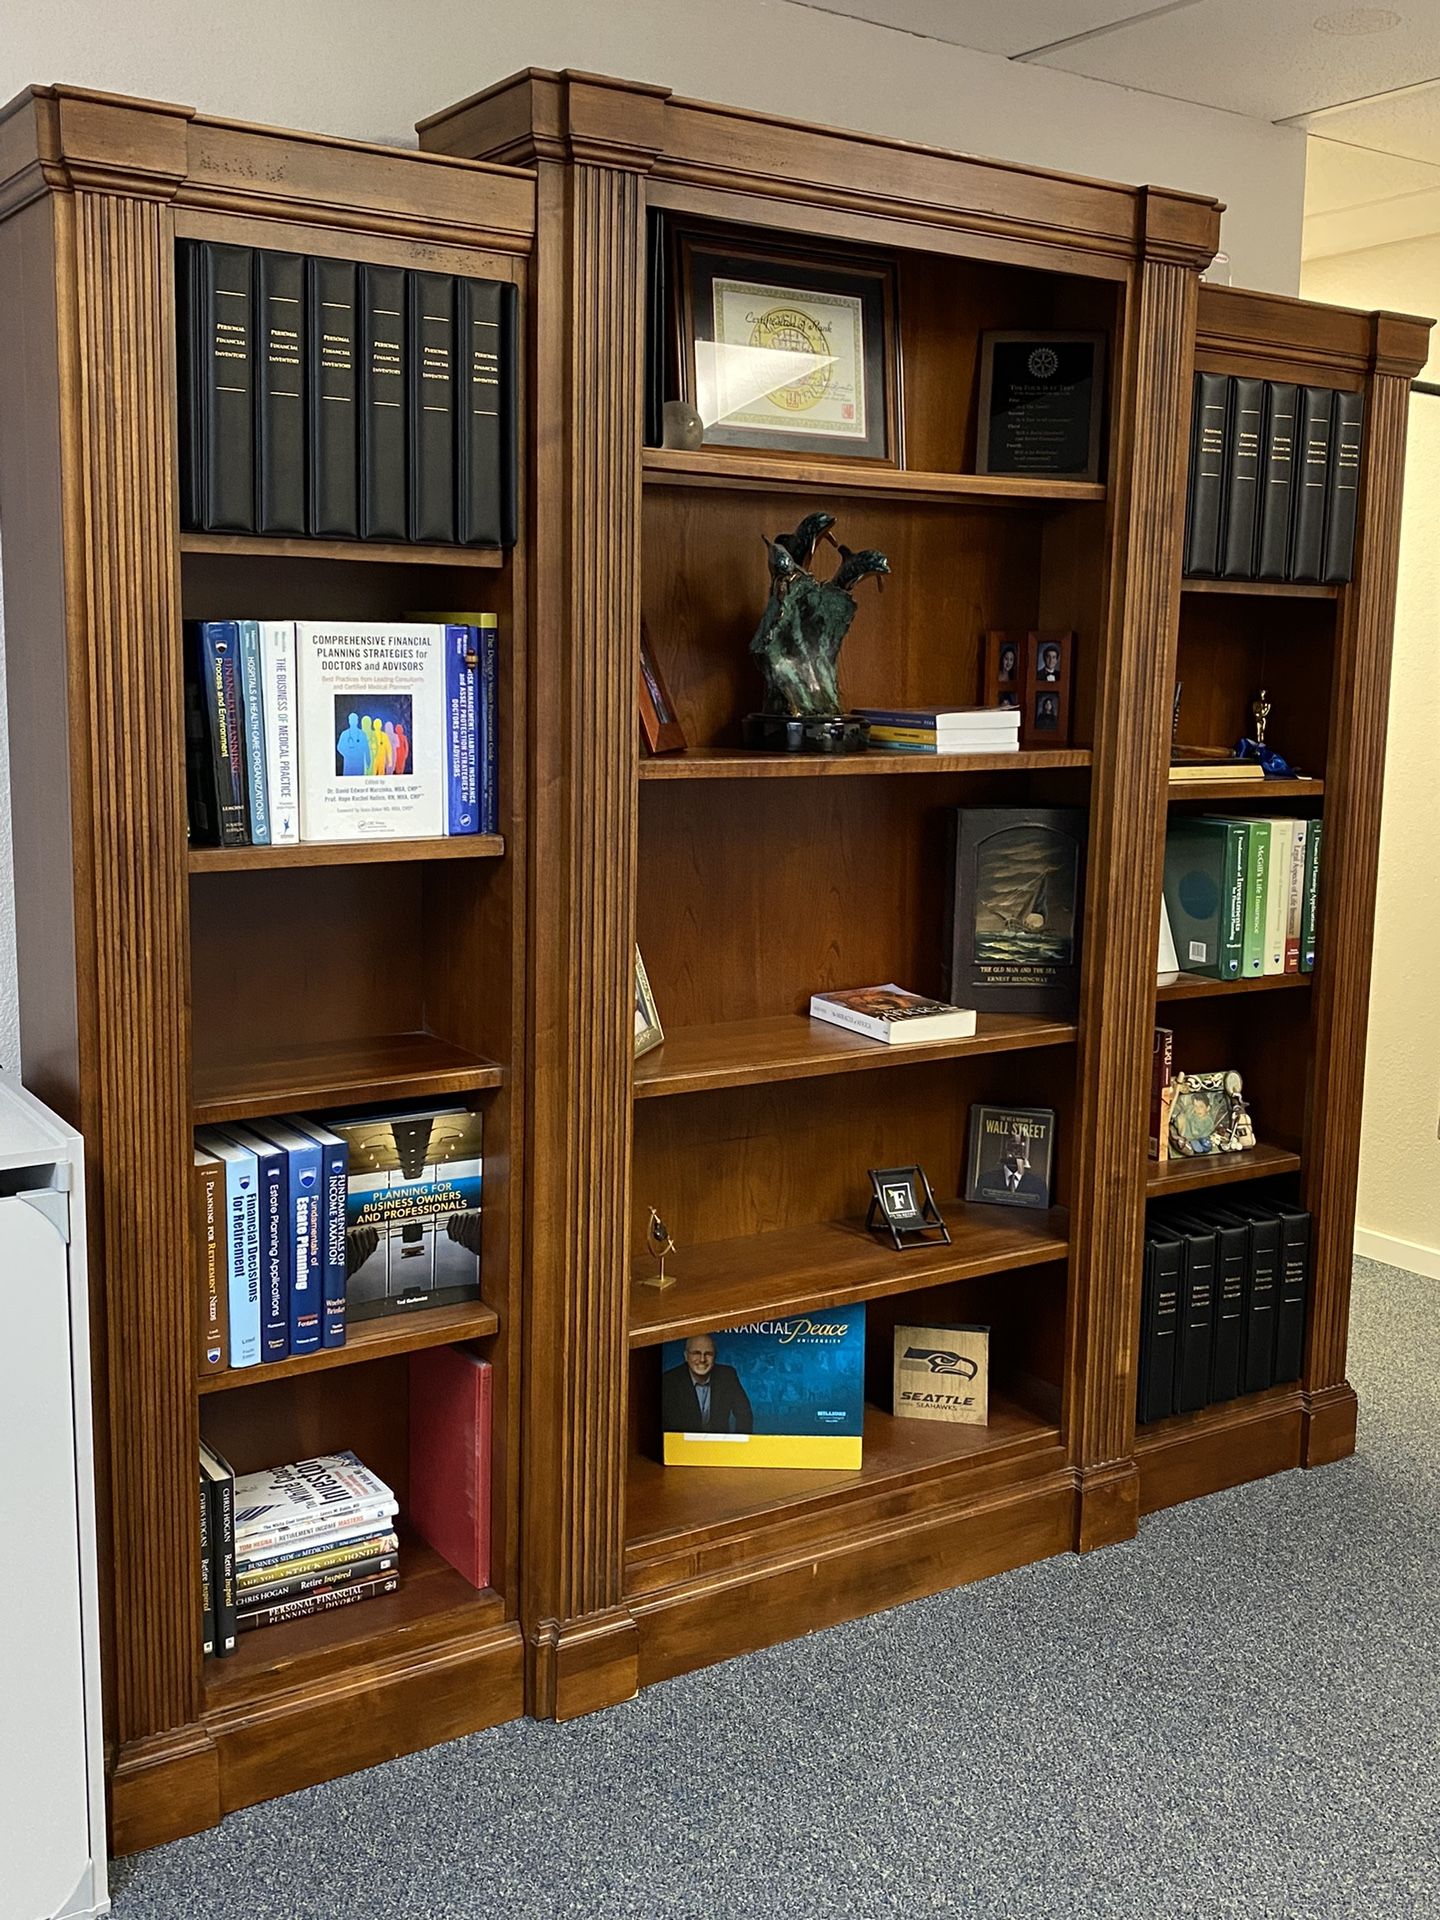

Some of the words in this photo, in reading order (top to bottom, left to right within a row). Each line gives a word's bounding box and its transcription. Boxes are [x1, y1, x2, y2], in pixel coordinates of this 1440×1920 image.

[313, 635, 386, 646] COMPREHENSIVE
[388, 636, 431, 646] FINANCIAL
[317, 648, 360, 658] PLANNING
[363, 649, 413, 658] STRATEGIES
[416, 650, 427, 658] for
[247, 656, 257, 694] HOSPITALS
[276, 658, 286, 672] THE
[322, 661, 361, 670] DOCTORS
[364, 662, 380, 670] and
[383, 662, 424, 670] ADVISORS
[225, 657, 235, 714] FINANCIAL
[277, 674, 287, 711] BUSINESS
[250, 703, 259, 729] HEALTH
[278, 714, 288, 723] OF
[219, 708, 229, 757] Environment
[252, 731, 260, 750] CARE
[278, 725, 289, 758] MEDICAL
[253, 751, 264, 820] ORGANIZATIONS
[280, 761, 291, 797] PRACTICE
[1257, 845, 1265, 877] McGill's
[1291, 845, 1300, 862] Legal
[1236, 878, 1244, 931] Investments
[986, 1120, 1009, 1134] WALL
[1011, 1123, 1046, 1138] STREET
[233, 1196, 244, 1213] for
[270, 1184, 278, 1214] Estate
[363, 1197, 413, 1212] BUSINESS
[416, 1191, 461, 1204] OWNERS
[373, 1185, 428, 1201] PLANNING
[432, 1182, 452, 1192] FOR
[893, 1190, 906, 1209] F
[247, 1193, 257, 1245] Financial
[297, 1197, 310, 1235] Estate
[311, 1195, 319, 1255] Fundamentals
[338, 1175, 346, 1252] FUNDAMENTALS
[357, 1212, 380, 1224] AND
[384, 1200, 467, 1220] PROFESSIONALS
[234, 1215, 245, 1278] Retirement
[270, 1216, 279, 1256] Planning
[296, 1236, 309, 1290] Planning
[311, 1257, 318, 1266] of
[338, 1255, 345, 1266] OF
[249, 1248, 258, 1303] Decisions
[270, 1258, 280, 1316] Applications
[779, 1319, 849, 1344] Peace
[900, 1392, 975, 1405] SEATTLE
[916, 1402, 957, 1411] SEAHAWKS
[295, 1460, 353, 1505] Investor
[222, 1488, 230, 1512] CHRIS
[223, 1513, 231, 1542] HOGAN
[279, 1528, 314, 1540] RETIREMENT
[315, 1522, 336, 1532] INCOME
[338, 1516, 364, 1526] MASTERS
[224, 1554, 232, 1577] Retire
[248, 1556, 279, 1569] BUSINESS
[280, 1552, 294, 1561] SIDE
[301, 1544, 334, 1557] MEDICINE
[285, 1562, 320, 1575] STOCK
[344, 1548, 378, 1561] BOND?
[202, 1583, 211, 1611] Inspired
[223, 1578, 233, 1607] Inspired
[236, 1594, 259, 1605] CHRIS
[261, 1587, 289, 1599] HOGAN
[301, 1578, 323, 1589] Retire
[324, 1569, 352, 1583] Inspired
[269, 1600, 314, 1616] PERSONAL
[317, 1586, 363, 1604] FINANCIAL
[270, 1607, 314, 1623] PLANNING
[325, 1595, 363, 1608] DIVORCE
